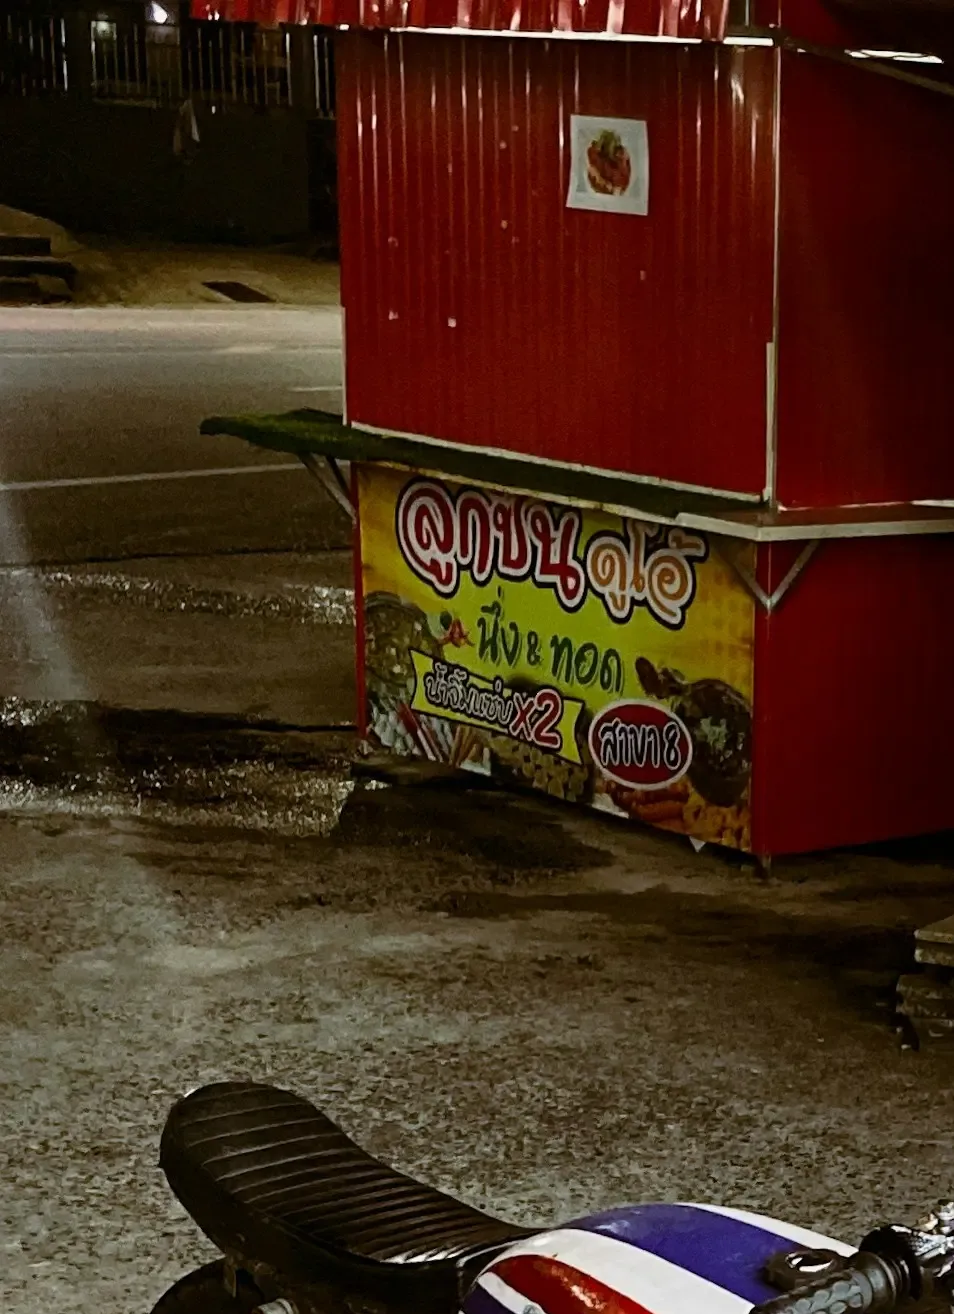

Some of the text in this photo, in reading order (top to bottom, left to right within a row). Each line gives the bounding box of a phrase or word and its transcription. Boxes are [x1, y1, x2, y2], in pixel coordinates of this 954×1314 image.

[527, 631, 541, 666] &
[551, 635, 622, 693] ทอด
[600, 718, 682, 771] สาขา 8
